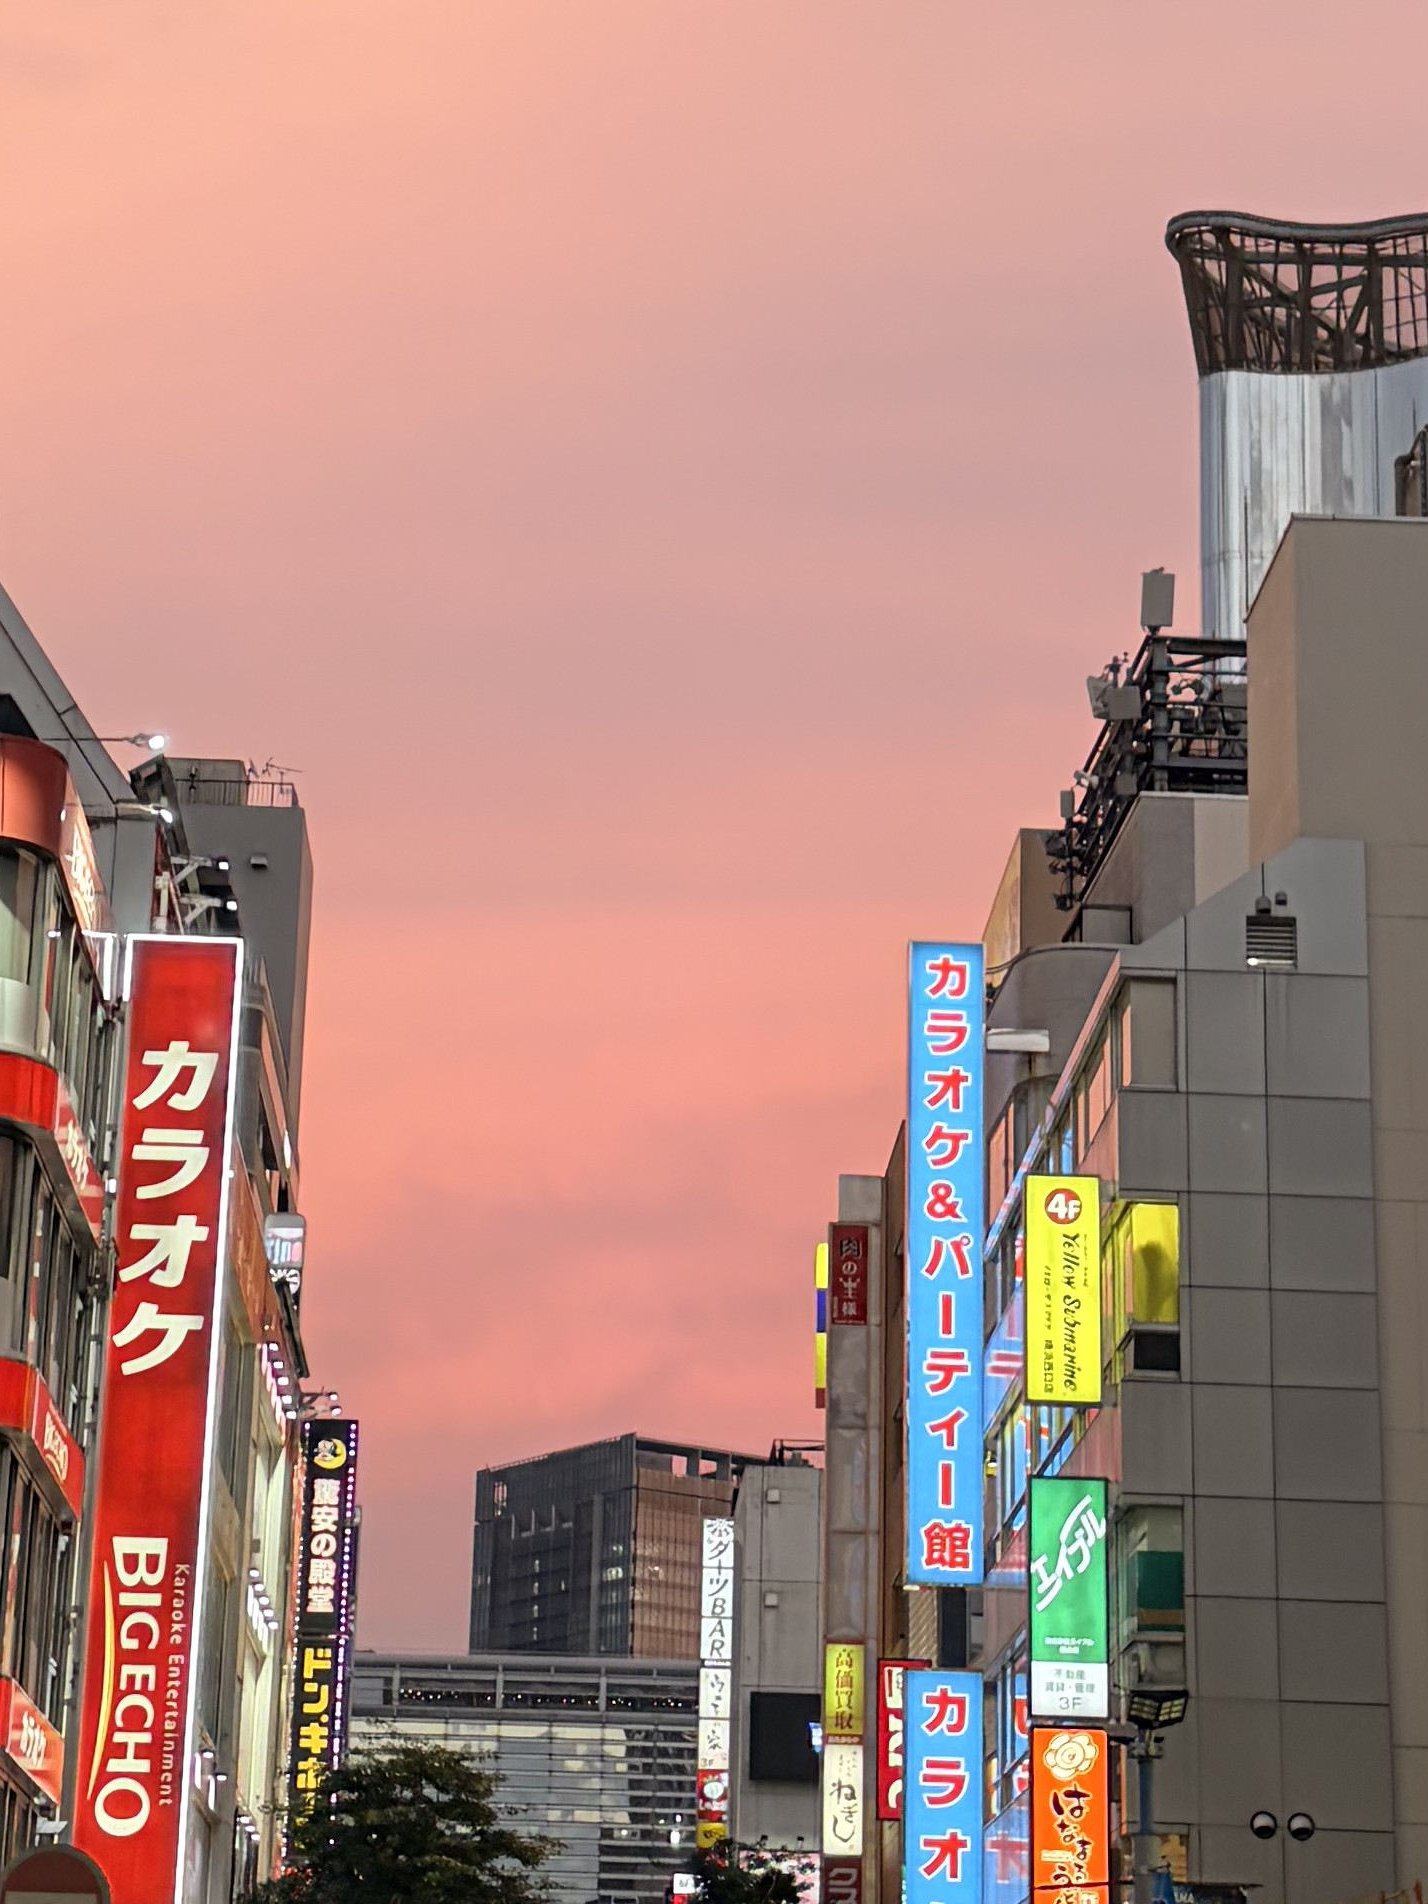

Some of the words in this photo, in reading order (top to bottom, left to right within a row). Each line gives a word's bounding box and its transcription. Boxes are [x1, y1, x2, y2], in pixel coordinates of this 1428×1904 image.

[111, 1039, 219, 1378] カラオケ
[1047, 1193, 1080, 1219] 4F
[922, 954, 973, 1573] カラオケ&パーティー館
[1062, 1233, 1080, 1290] Yellow
[1063, 1294, 1081, 1393] Submarine
[111, 1536, 169, 1650] BIG
[169, 1563, 191, 1644] Karaoke
[157, 1653, 185, 1807] Entertainment
[834, 1649, 854, 1731] 高価買取
[1059, 1697, 1083, 1710] 3F
[95, 1665, 156, 1837] ECHO
